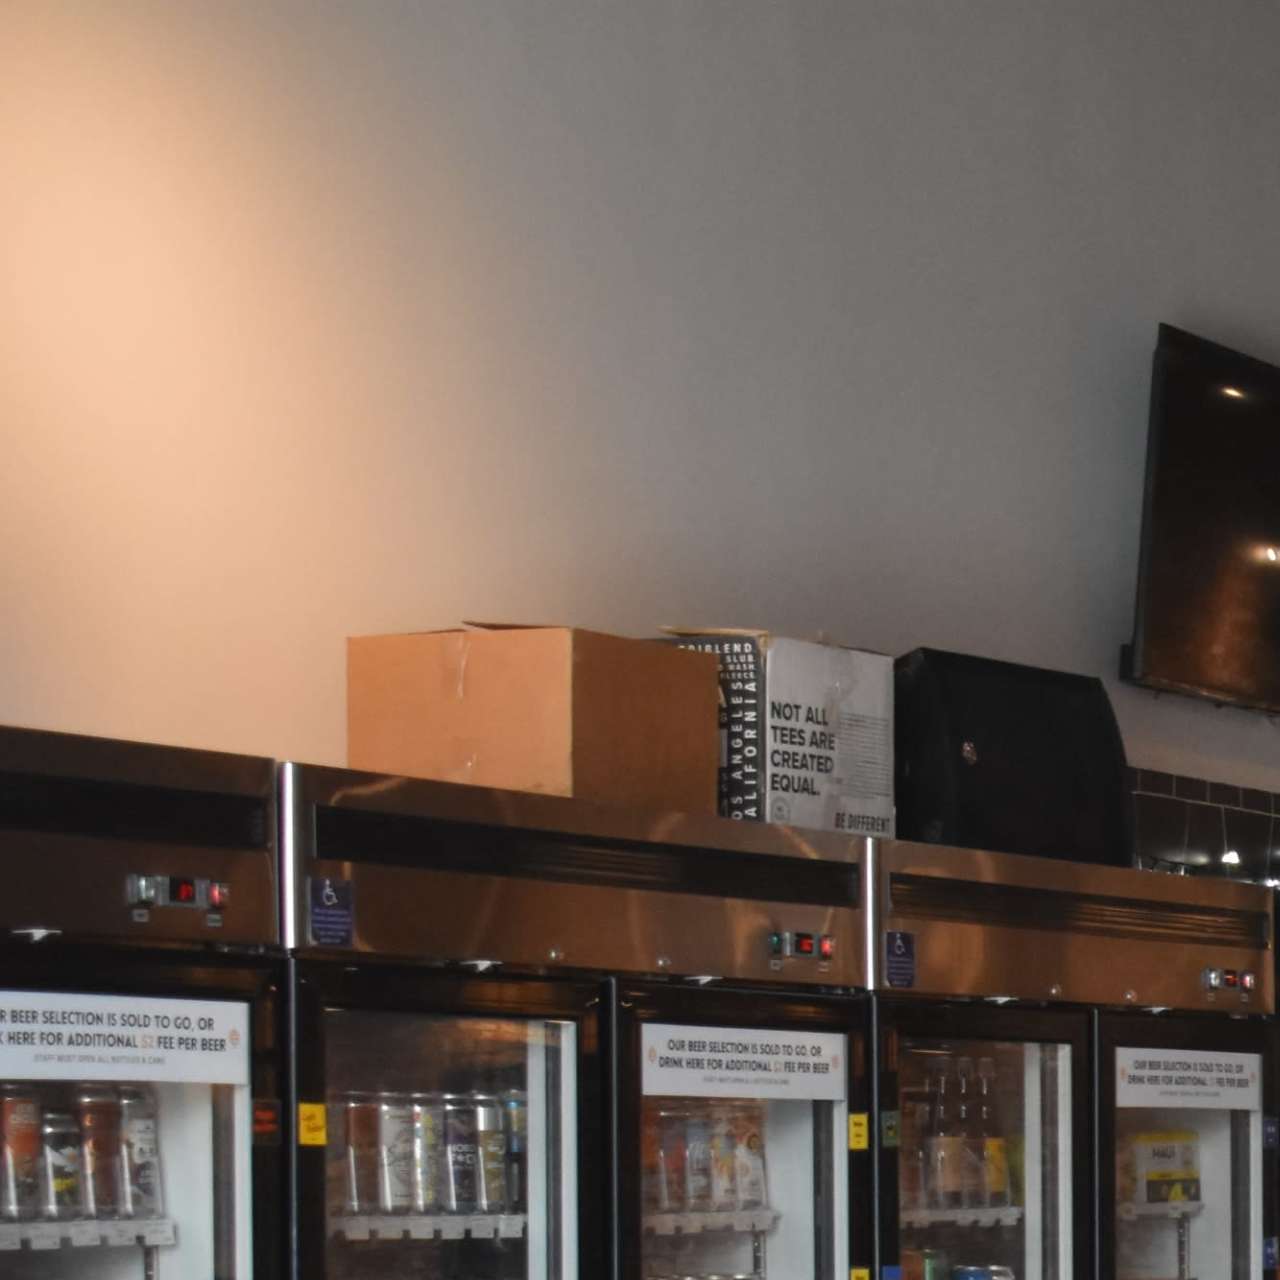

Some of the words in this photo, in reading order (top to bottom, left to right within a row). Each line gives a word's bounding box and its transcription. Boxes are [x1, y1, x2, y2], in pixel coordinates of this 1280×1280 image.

[771, 701, 801, 721] NOT
[805, 706, 828, 727] ALL
[731, 681, 744, 780] ANGELES
[771, 725, 805, 746] TEES
[809, 730, 836, 751] ARE
[745, 682, 758, 818] ALIFORNIA
[770, 749, 834, 774] CREATED
[771, 773, 821, 796] EQUAL.
[731, 796, 744, 821] OS
[835, 812, 845, 828] BE
[848, 813, 890, 832] DIFFERENT
[10, 1009, 39, 1024] BEER
[42, 1010, 103, 1025] SELECTION
[107, 1012, 117, 1026] IS
[121, 1013, 150, 1028] SOLD
[155, 1015, 170, 1029] TO
[198, 1017, 215, 1031] OR
[8, 1032, 36, 1045] HERE
[40, 1032, 64, 1046] FOR
[67, 1032, 138, 1049] ADDITIONAL
[157, 1036, 174, 1049] FEE
[178, 1037, 197, 1050] PER
[201, 1037, 226, 1051] BEER
[668, 1039, 686, 1050] OUR
[688, 1041, 707, 1052] BEER
[709, 1042, 750, 1054] SELECTION
[752, 1044, 758, 1054] IS
[759, 1044, 780, 1055] SOLD
[782, 1045, 793, 1055] TO
[810, 1046, 822, 1056] OR
[659, 1056, 683, 1068] DRINK
[686, 1058, 704, 1069] HERE
[707, 1059, 722, 1070] FOR
[725, 1059, 772, 1072] ADDITIONAL
[784, 1062, 795, 1073] FEE
[797, 1062, 810, 1073] PER
[813, 1063, 829, 1074] BEER
